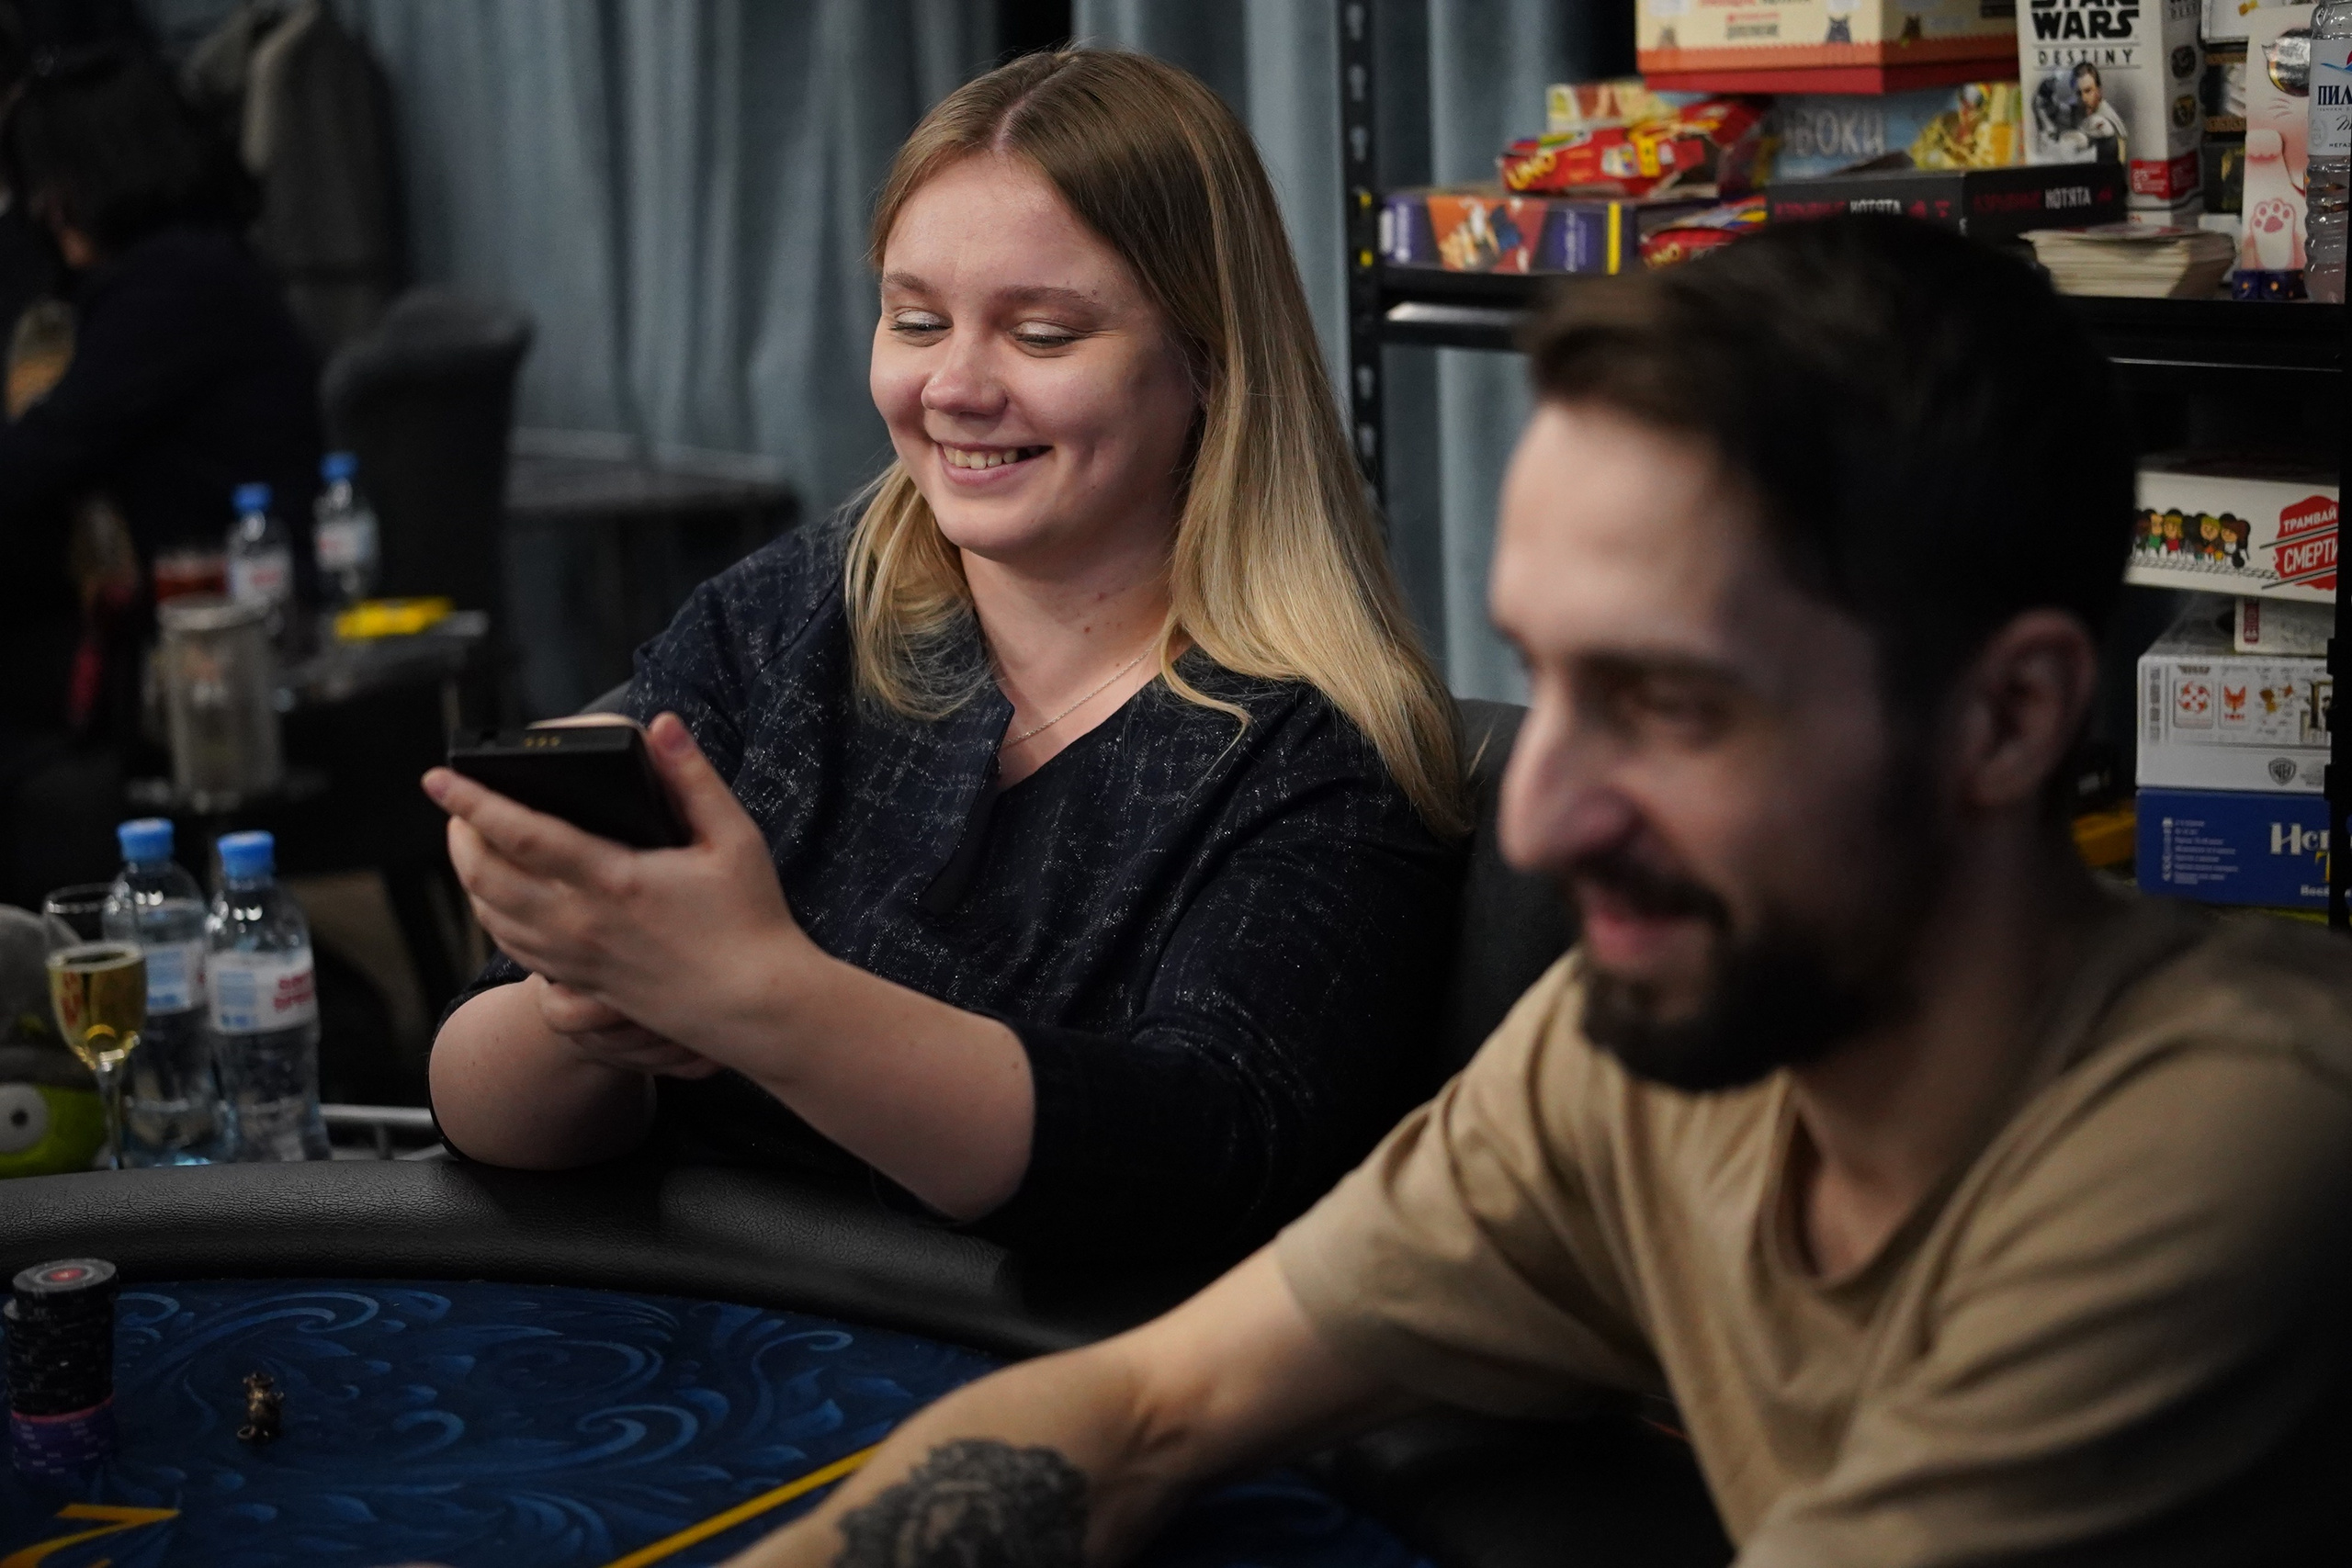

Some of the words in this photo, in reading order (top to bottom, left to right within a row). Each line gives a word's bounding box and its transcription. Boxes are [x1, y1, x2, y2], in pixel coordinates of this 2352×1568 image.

[2031, 9, 2138, 39] WARS
[2039, 49, 2132, 65] DESTINY
[2045, 186, 2092, 209] КОТЯТА
[2284, 504, 2337, 532] ТРАМВАЙ
